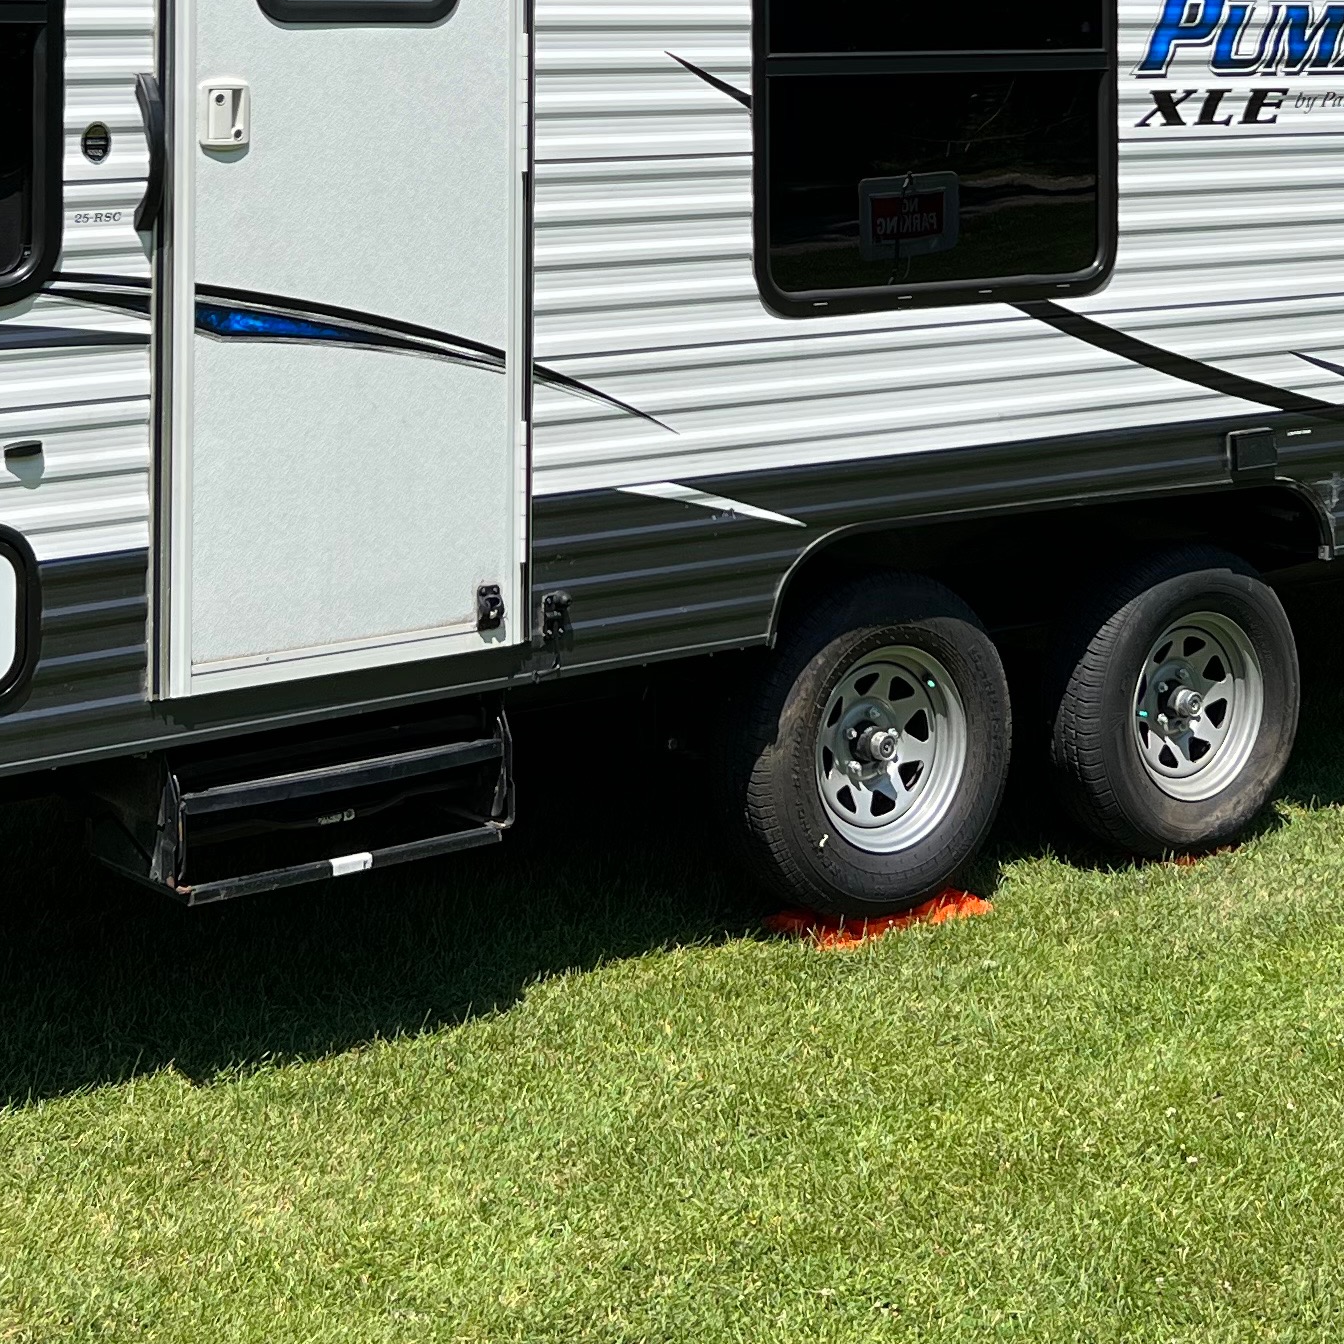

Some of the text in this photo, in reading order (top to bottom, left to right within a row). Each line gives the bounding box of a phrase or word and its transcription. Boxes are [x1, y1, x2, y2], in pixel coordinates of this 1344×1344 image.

[1134, 87, 1290, 127] XLE
[1294, 91, 1320, 114] by
[74, 211, 122, 224] 25-RSC
